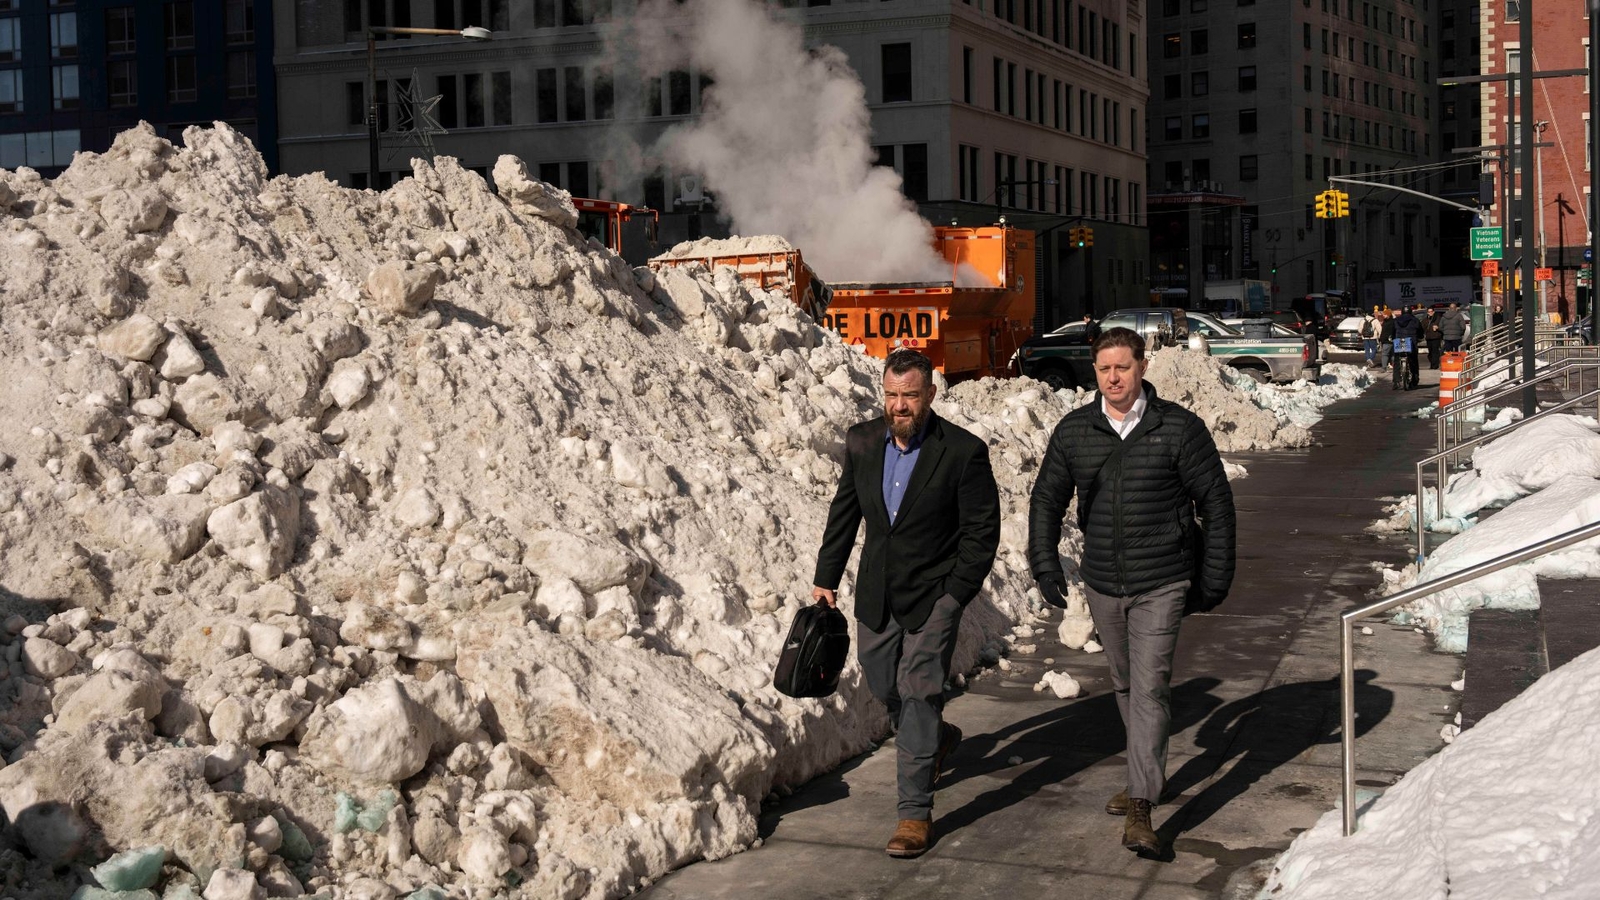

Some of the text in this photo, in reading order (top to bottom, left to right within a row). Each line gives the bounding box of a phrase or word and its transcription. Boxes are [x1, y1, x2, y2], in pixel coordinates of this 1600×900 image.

[1398, 282, 1416, 298] TRS
[821, 312, 932, 339] DE LOAD
